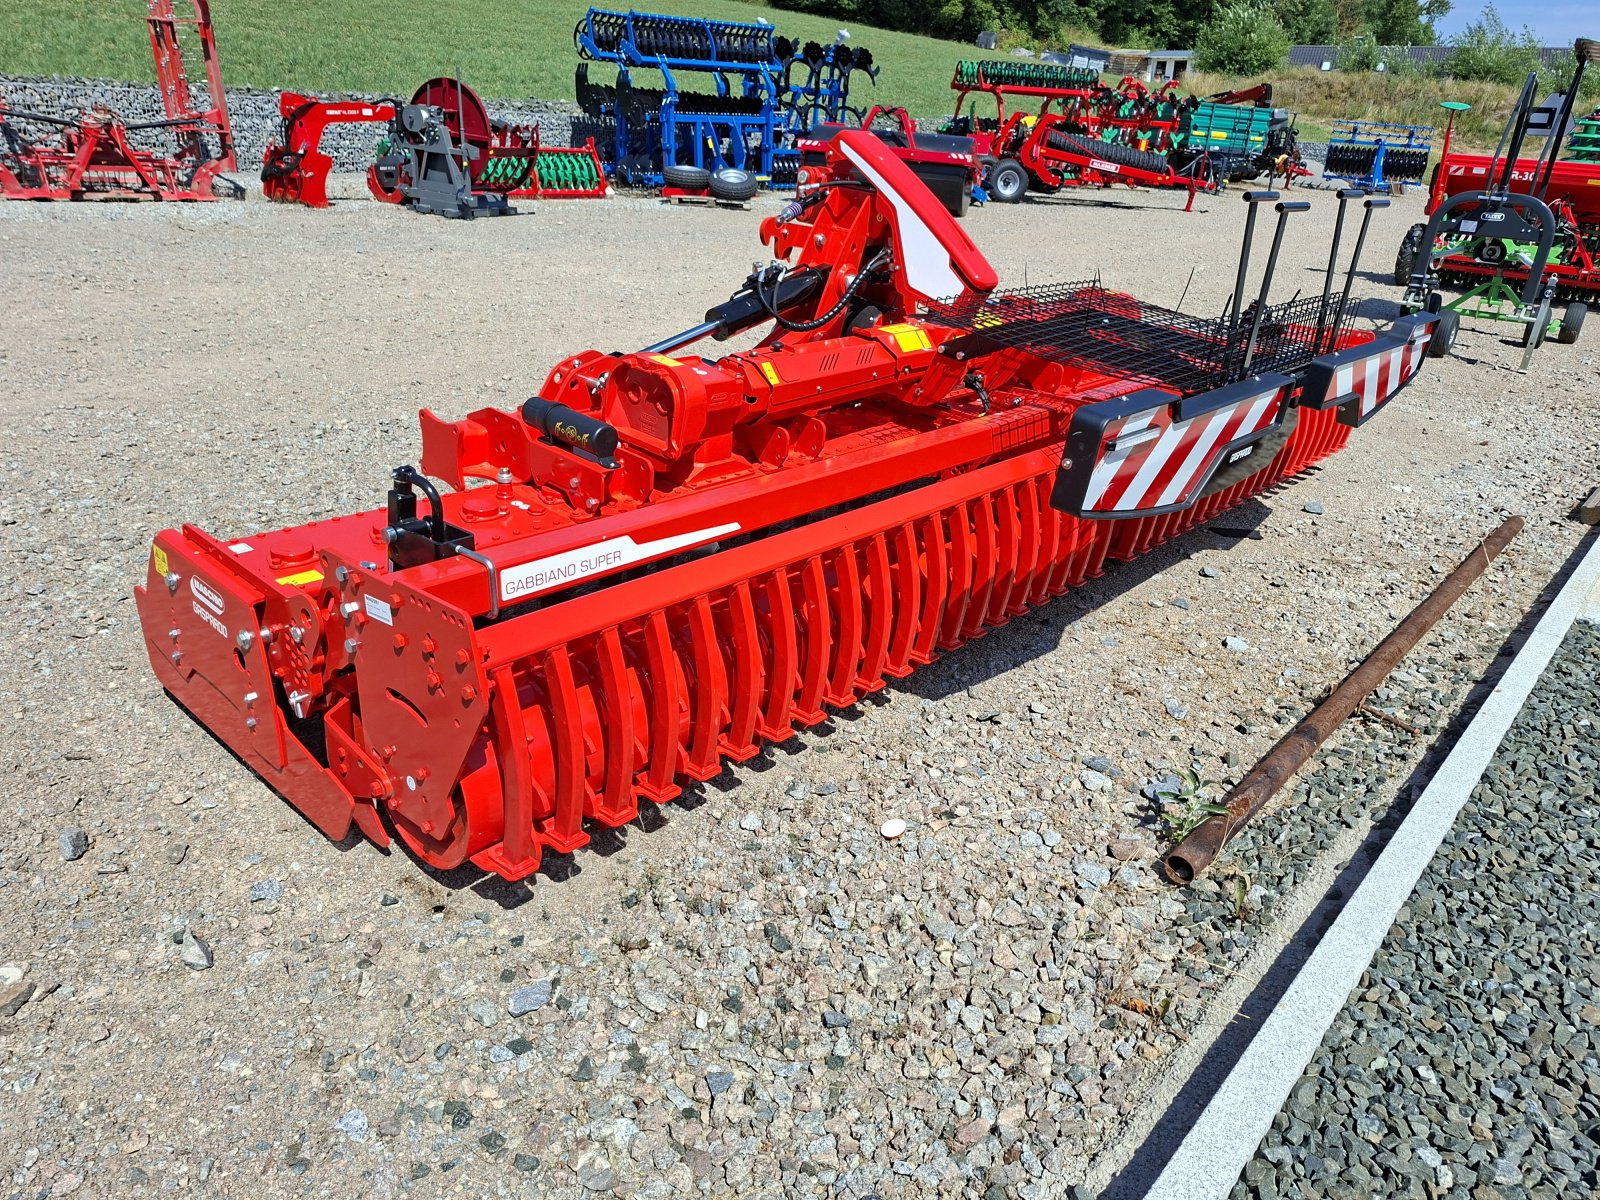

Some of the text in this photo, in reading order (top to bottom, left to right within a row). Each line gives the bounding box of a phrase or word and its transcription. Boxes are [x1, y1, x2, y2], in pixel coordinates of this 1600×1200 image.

[505, 550, 622, 594] GABBIANO SUPER
[193, 578, 223, 608] MASCHIO
[192, 600, 228, 639] GASPARDO
